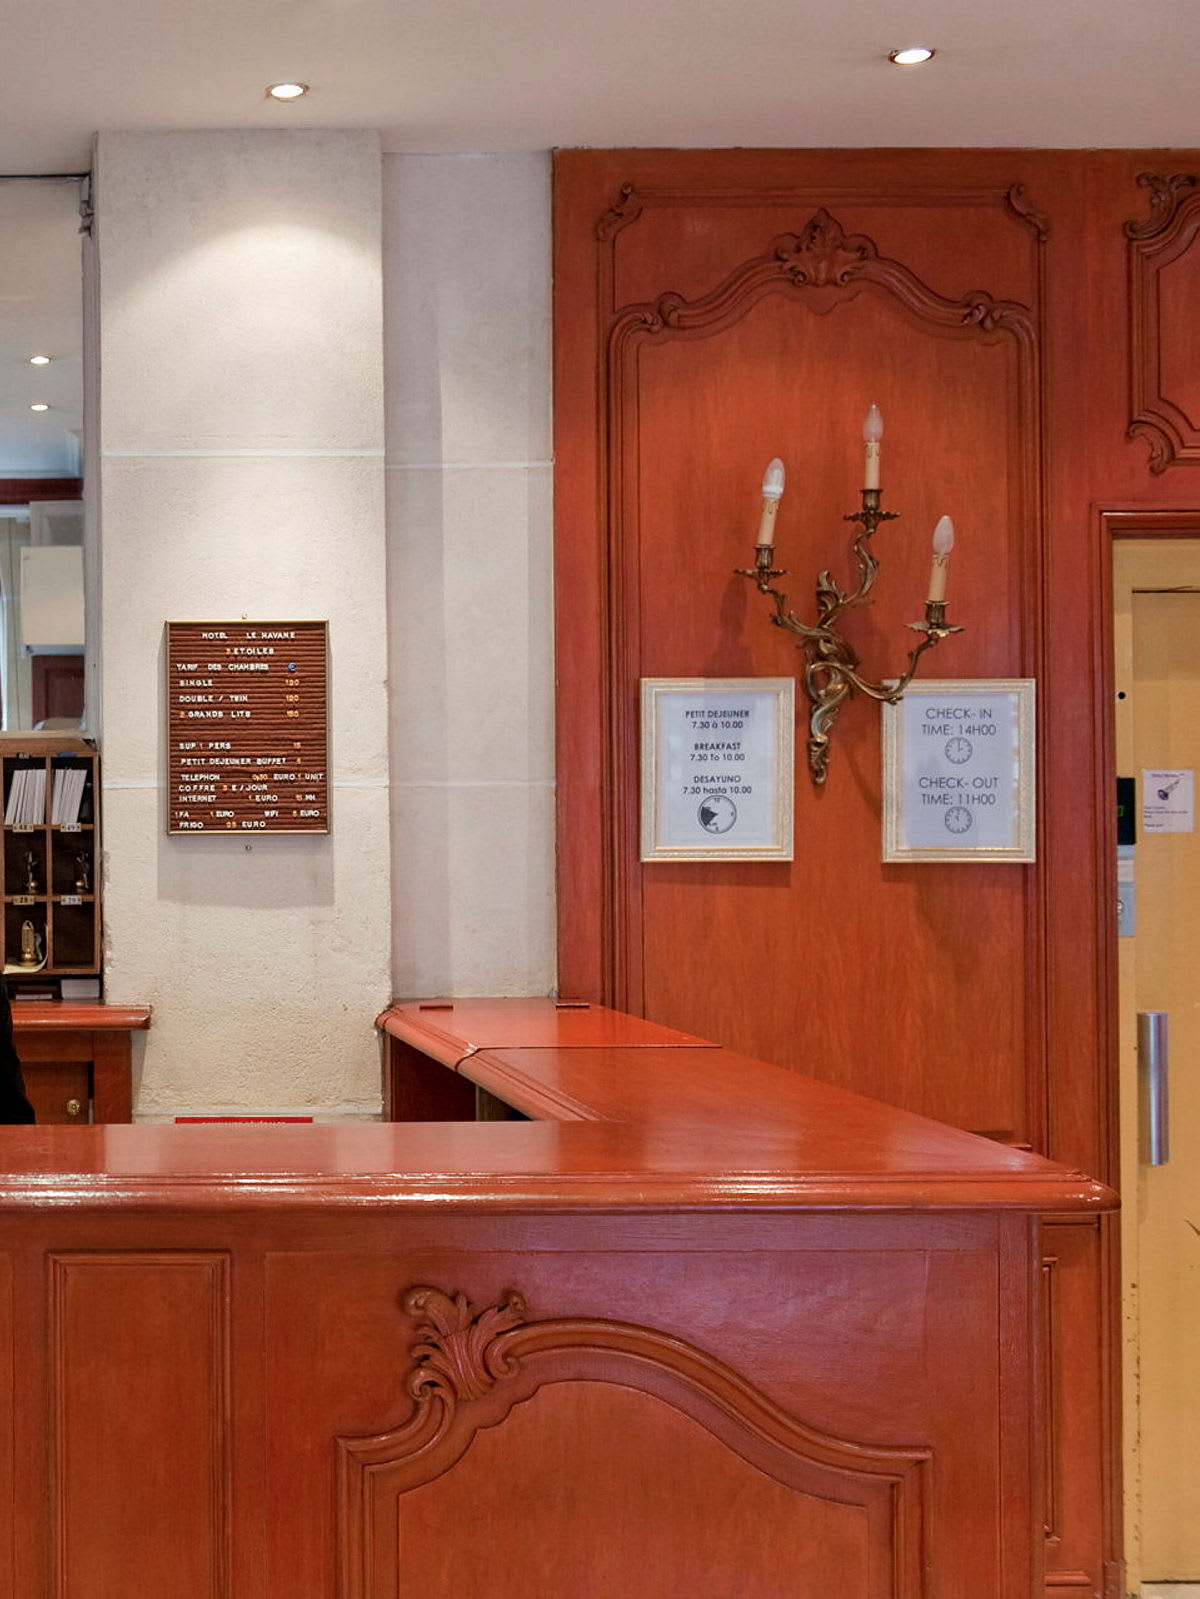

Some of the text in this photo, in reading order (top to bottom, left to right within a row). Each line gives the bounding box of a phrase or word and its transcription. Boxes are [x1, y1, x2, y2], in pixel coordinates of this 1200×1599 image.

[176, 663, 199, 671] TARIF
[207, 663, 221, 671] DES
[228, 663, 269, 671] CHAMBRES
[179, 679, 213, 687] SINGLE
[685, 710, 750, 718] PETIT DEJEUNER
[979, 708, 992, 719] IN
[692, 721, 710, 729] 7.30
[721, 721, 743, 729] 10.00
[921, 724, 996, 736] TIME: 14H00
[179, 742, 195, 750] SUP
[208, 742, 231, 750] PERS
[694, 742, 741, 750] BREAKFAST
[972, 777, 999, 789] OUT
[683, 786, 752, 794] 7.30 hasta 10.00
[921, 794, 996, 805] TIME: 11H00
[179, 821, 204, 829] FRIGO
[241, 821, 266, 829] EURO
